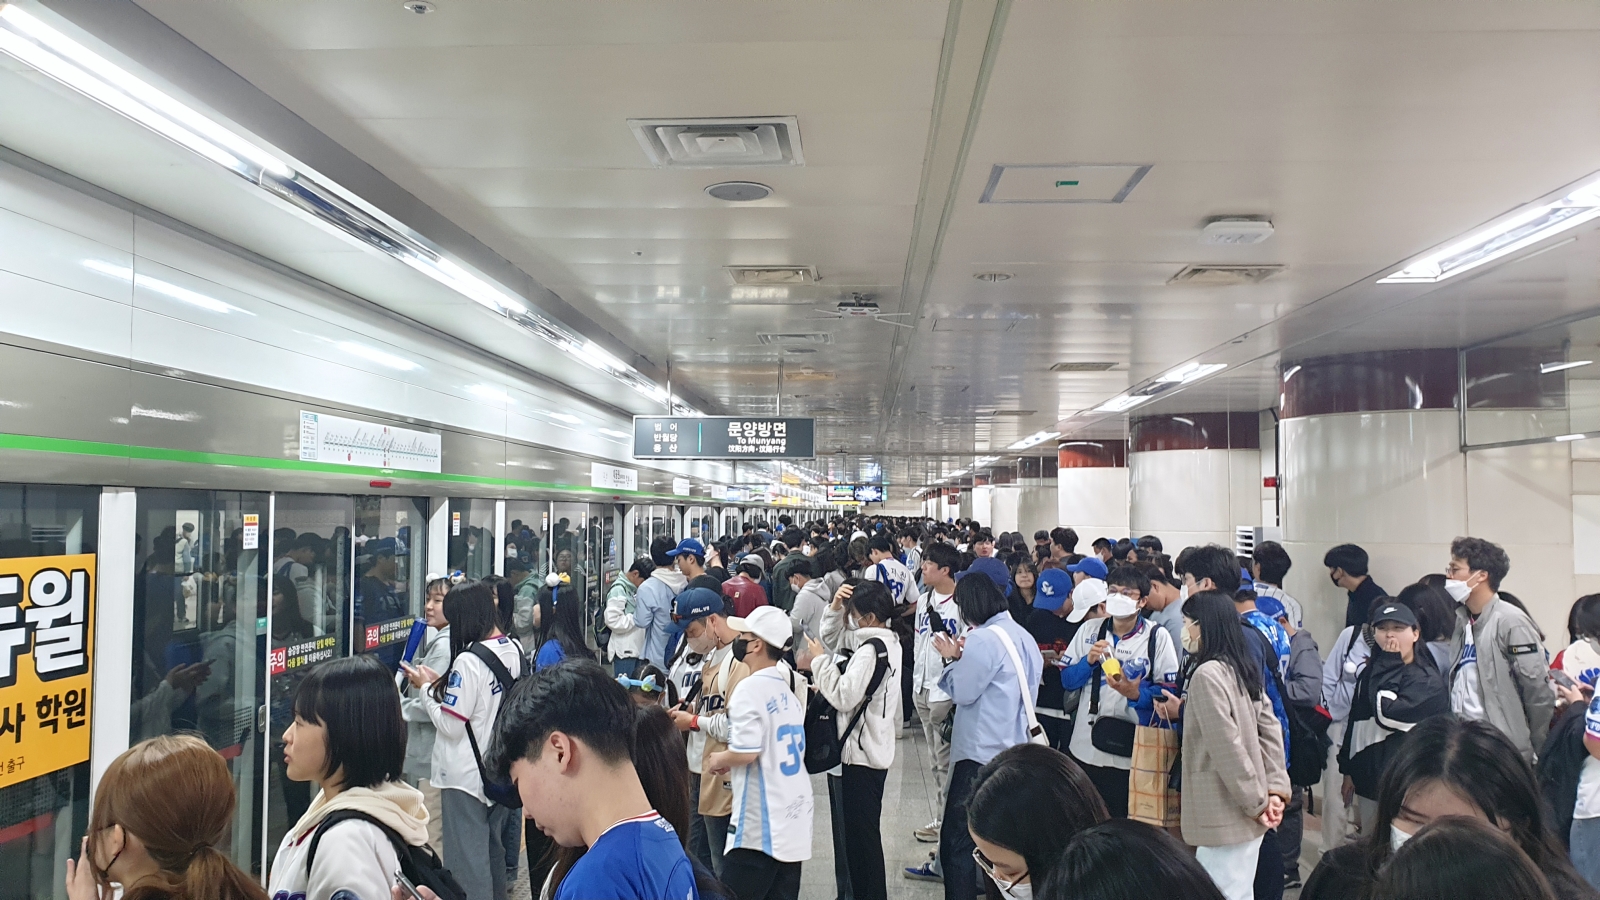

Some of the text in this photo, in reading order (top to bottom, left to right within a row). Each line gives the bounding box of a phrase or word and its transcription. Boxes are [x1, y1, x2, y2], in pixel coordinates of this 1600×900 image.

[654, 433, 678, 442] 반월당
[728, 422, 786, 437] 문양방면
[748, 437, 786, 446] Munyang
[366, 628, 379, 645] 주의
[288, 645, 300, 656] 승강장
[301, 640, 316, 653] 안전문이
[270, 650, 285, 672] 주의
[287, 658, 296, 668] 다음
[36, 688, 87, 734] 학원
[7, 756, 25, 774] 출구
